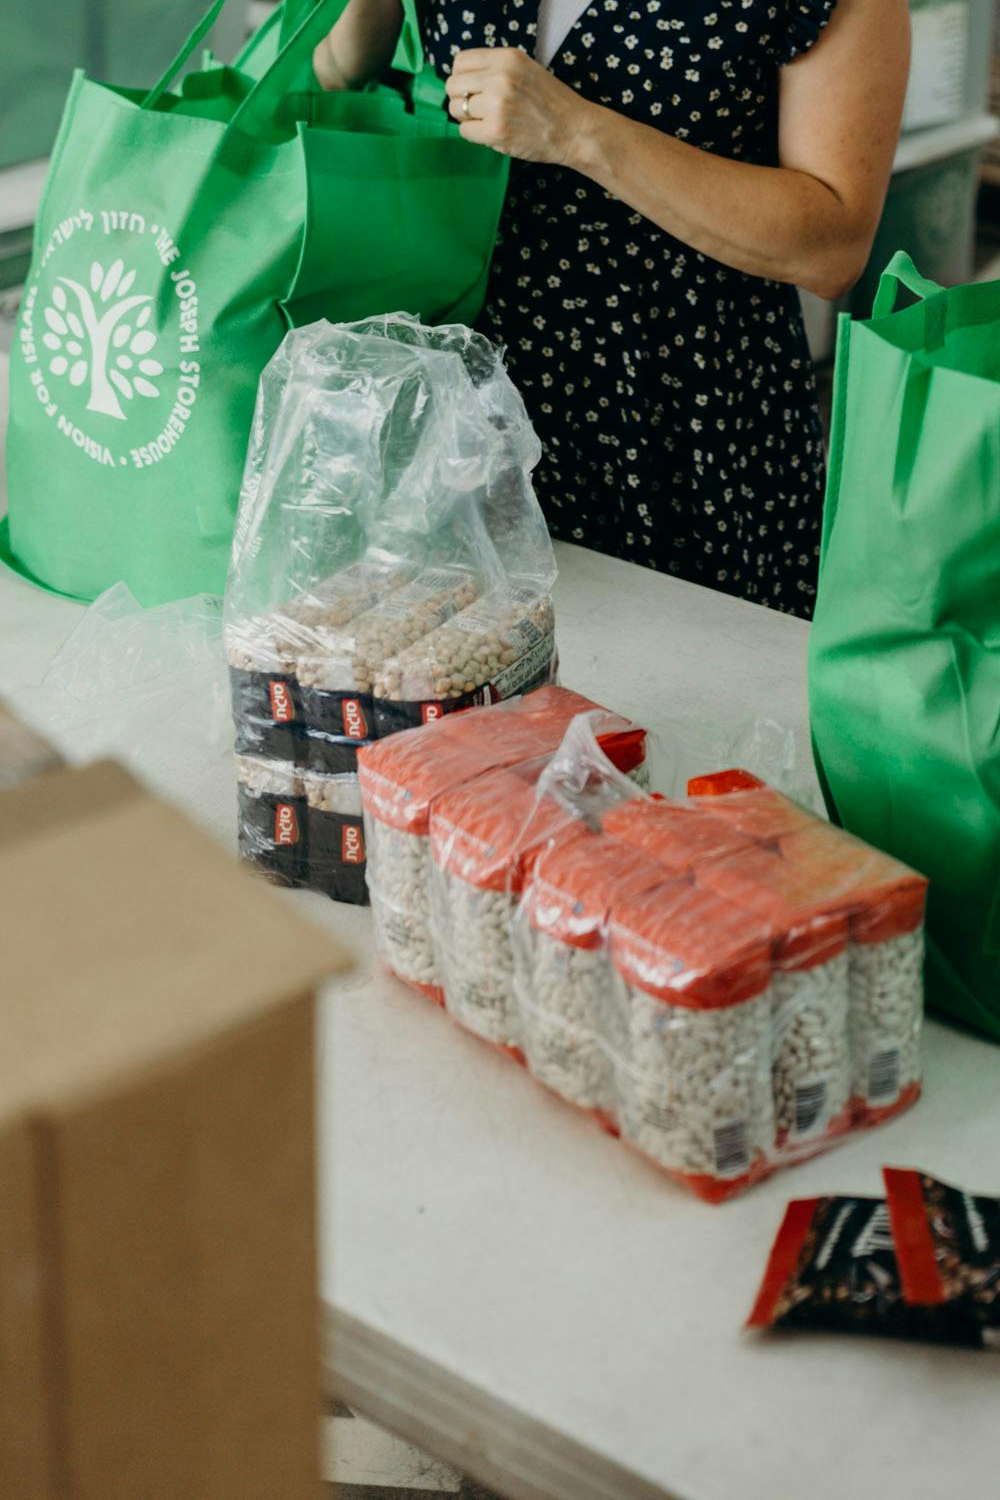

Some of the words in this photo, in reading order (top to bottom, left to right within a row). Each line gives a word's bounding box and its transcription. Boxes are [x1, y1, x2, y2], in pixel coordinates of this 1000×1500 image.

[102, 210, 146, 235] חזון
[151, 228, 182, 266] THE
[20, 286, 38, 364] ISRAEL
[171, 270, 200, 354] JOSEPH
[30, 368, 58, 417] FOR
[130, 361, 201, 469] STOREHOUSE
[57, 415, 116, 467] VISION
[272, 683, 288, 720] סוגת
[345, 701, 361, 736] סוגת
[279, 807, 294, 844] סוגת
[346, 828, 358, 862] סוגת
